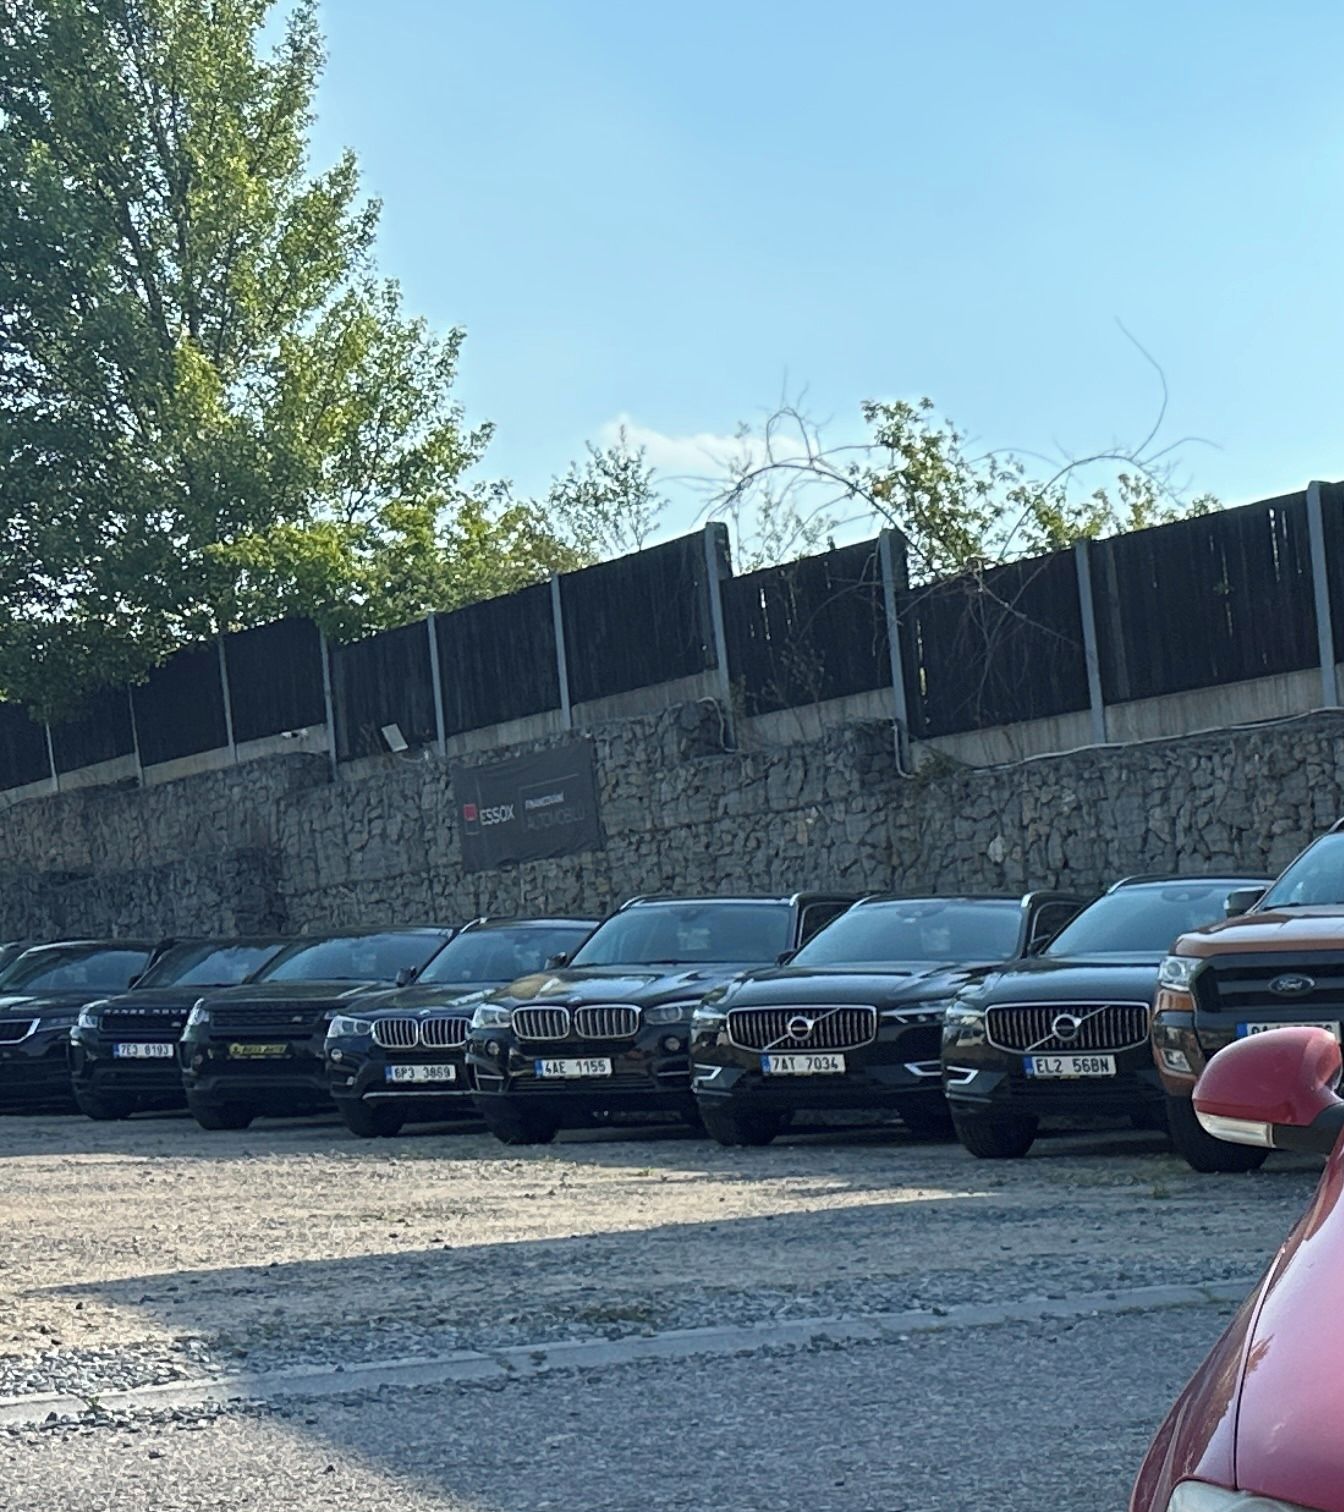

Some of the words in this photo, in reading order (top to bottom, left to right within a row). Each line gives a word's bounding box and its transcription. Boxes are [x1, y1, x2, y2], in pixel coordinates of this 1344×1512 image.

[480, 804, 515, 826] ESSOX
[772, 1057, 794, 1070] 7AT
[805, 1057, 838, 1070] 7034
[1035, 1059, 1062, 1073] EL2
[1072, 1058, 1109, 1073] 56BN
